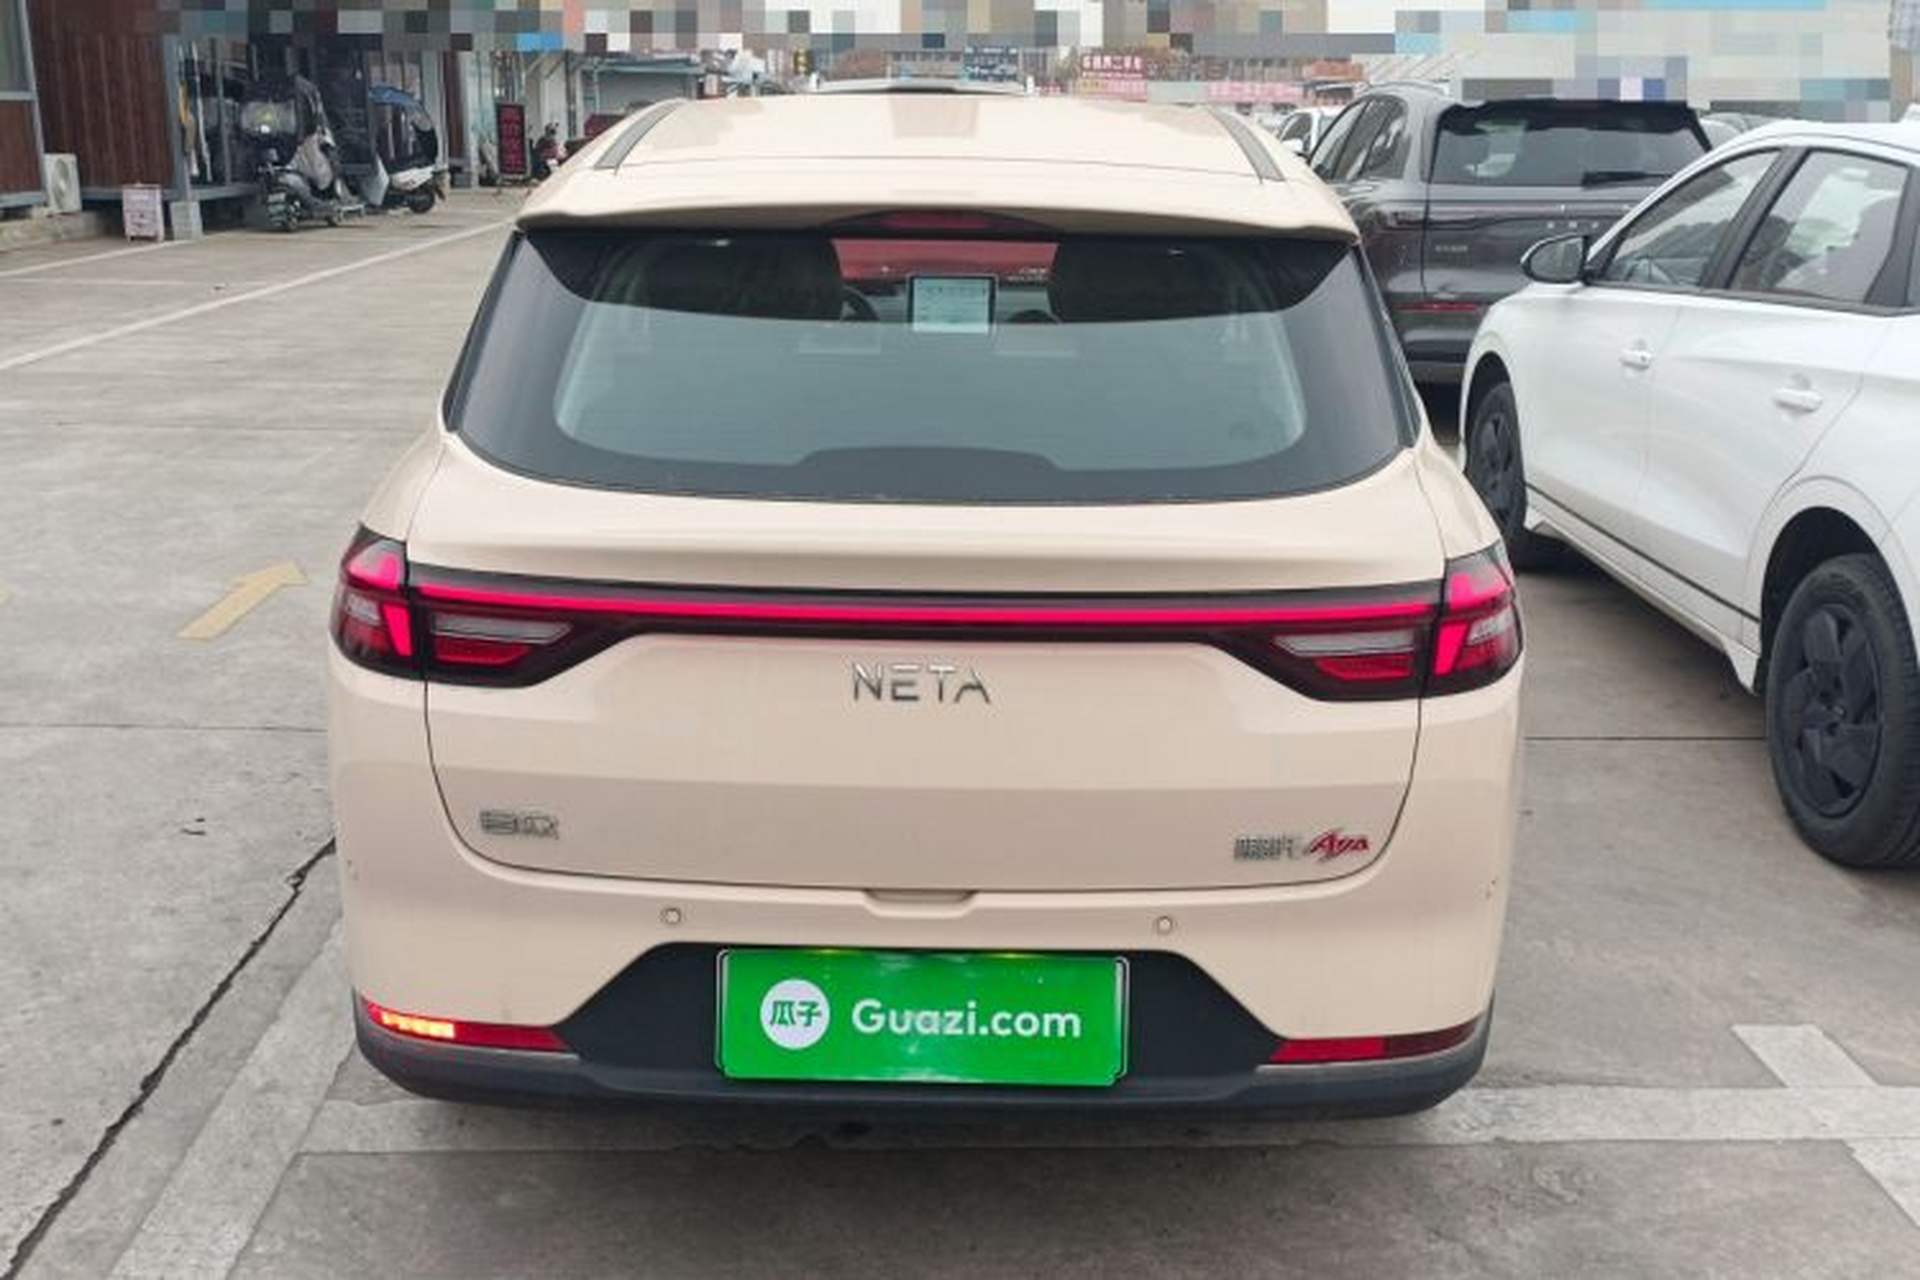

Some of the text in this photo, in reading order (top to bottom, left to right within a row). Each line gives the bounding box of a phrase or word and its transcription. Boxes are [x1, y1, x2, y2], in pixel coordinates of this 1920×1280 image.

[851, 662, 991, 704] NETA
[768, 999, 823, 1028] 瓜子
[850, 998, 1082, 1038] Guazi.com
